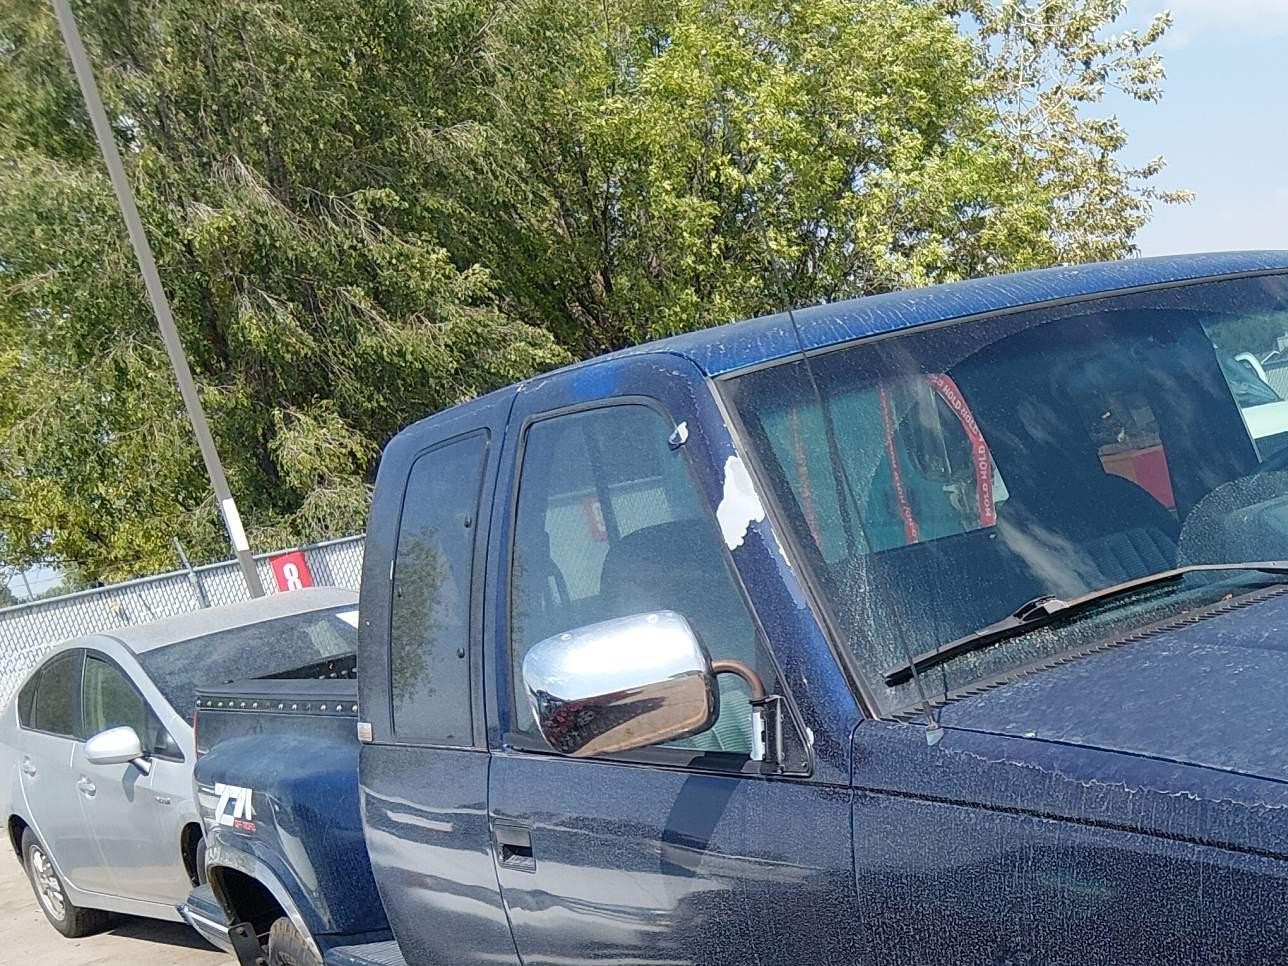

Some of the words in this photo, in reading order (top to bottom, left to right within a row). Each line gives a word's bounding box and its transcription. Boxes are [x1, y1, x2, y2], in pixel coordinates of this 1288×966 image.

[978, 444, 988, 480] HOLD
[982, 482, 992, 517] HOLD
[283, 562, 303, 592] 8
